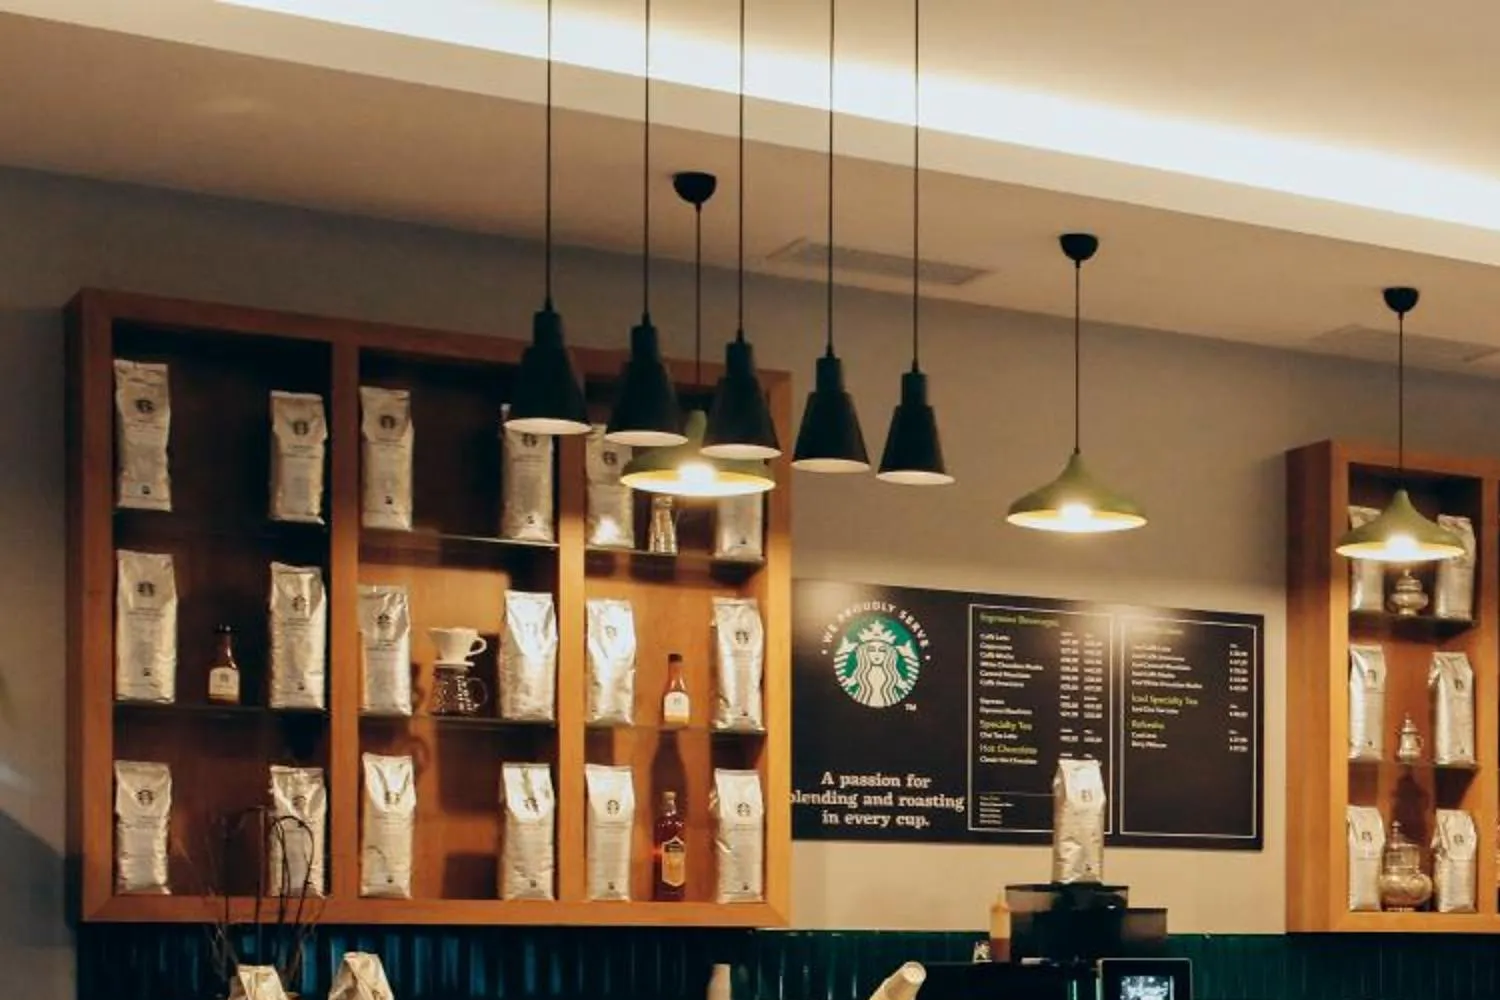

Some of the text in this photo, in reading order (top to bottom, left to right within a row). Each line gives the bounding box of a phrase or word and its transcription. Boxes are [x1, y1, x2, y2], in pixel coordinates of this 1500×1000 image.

[822, 623, 839, 643] WE
[899, 609, 930, 648] SERVE
[820, 771, 932, 789] A passion for
[862, 791, 893, 807] and
[897, 793, 965, 813] roasting
[821, 809, 931, 830] in every cup.
